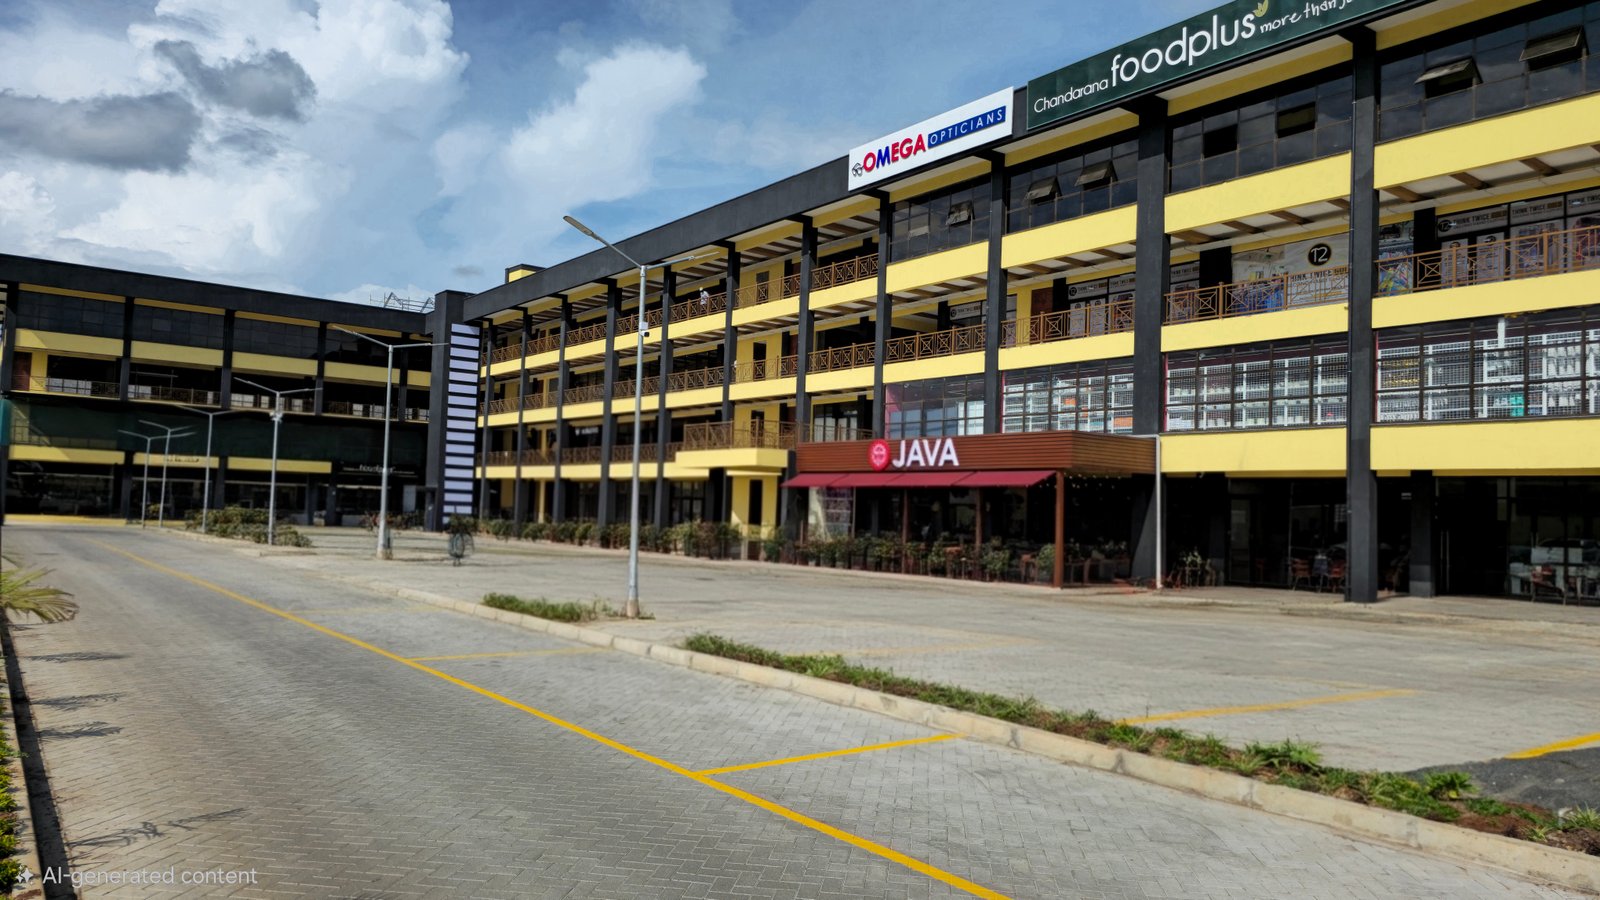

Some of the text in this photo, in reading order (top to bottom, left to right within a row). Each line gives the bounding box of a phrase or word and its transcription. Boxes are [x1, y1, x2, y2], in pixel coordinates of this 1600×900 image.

[1034, 79, 1109, 113] Chandarana
[1110, 13, 1256, 87] foodplus
[1259, 12, 1302, 34] more
[1303, 0, 1337, 19] than
[863, 109, 1003, 173] OMEGA OPTICIANS
[892, 437, 960, 468] JAVA
